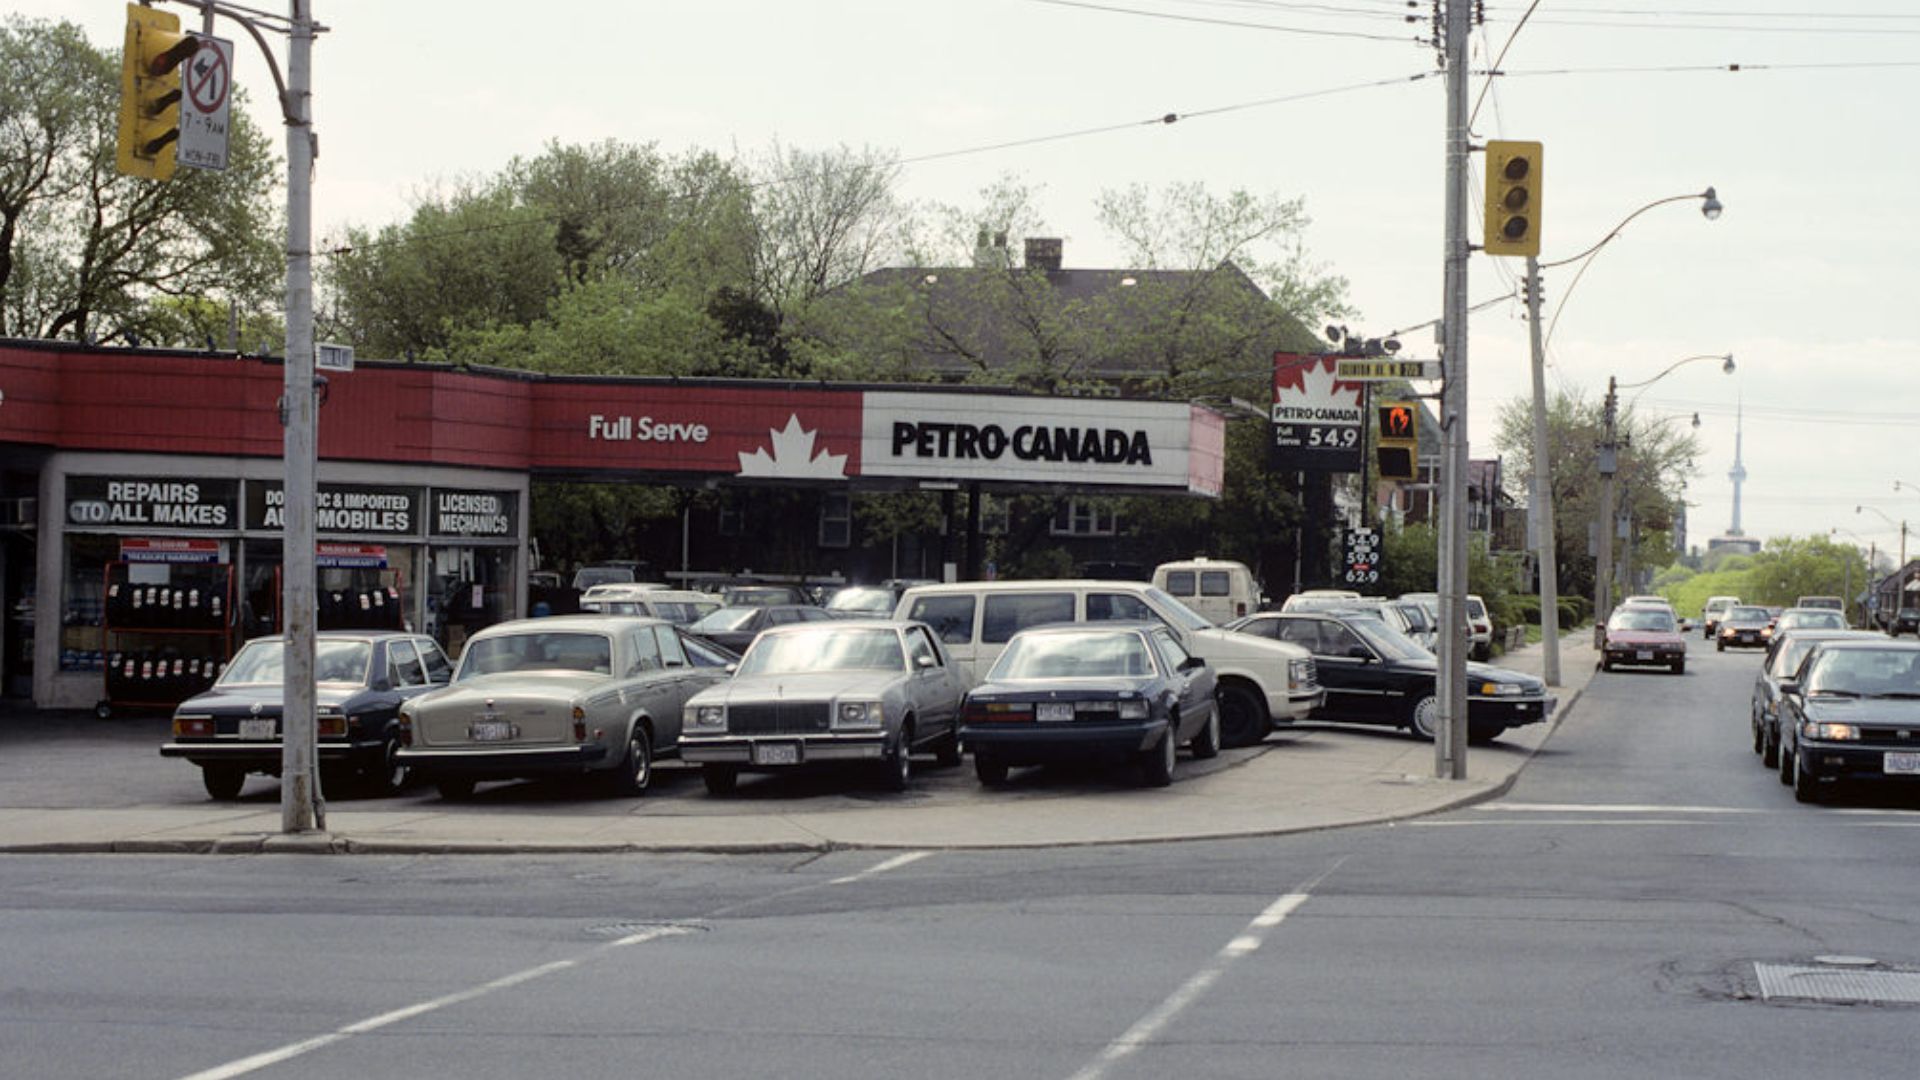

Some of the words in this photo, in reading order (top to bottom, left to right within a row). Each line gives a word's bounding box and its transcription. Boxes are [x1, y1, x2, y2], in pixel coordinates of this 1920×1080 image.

[590, 415, 631, 440] Full
[637, 416, 709, 442] Serve
[1308, 427, 1358, 448] 54.9
[108, 481, 200, 503] REPAIRS
[333, 494, 342, 507] &
[344, 494, 409, 510] IMPORTED
[78, 501, 105, 521] TO
[110, 503, 149, 522] ALL
[153, 505, 227, 525] MAKES
[439, 494, 497, 513] LICENSED
[439, 513, 508, 533] MECHANICS
[1345, 570, 1378, 583] 62.9
